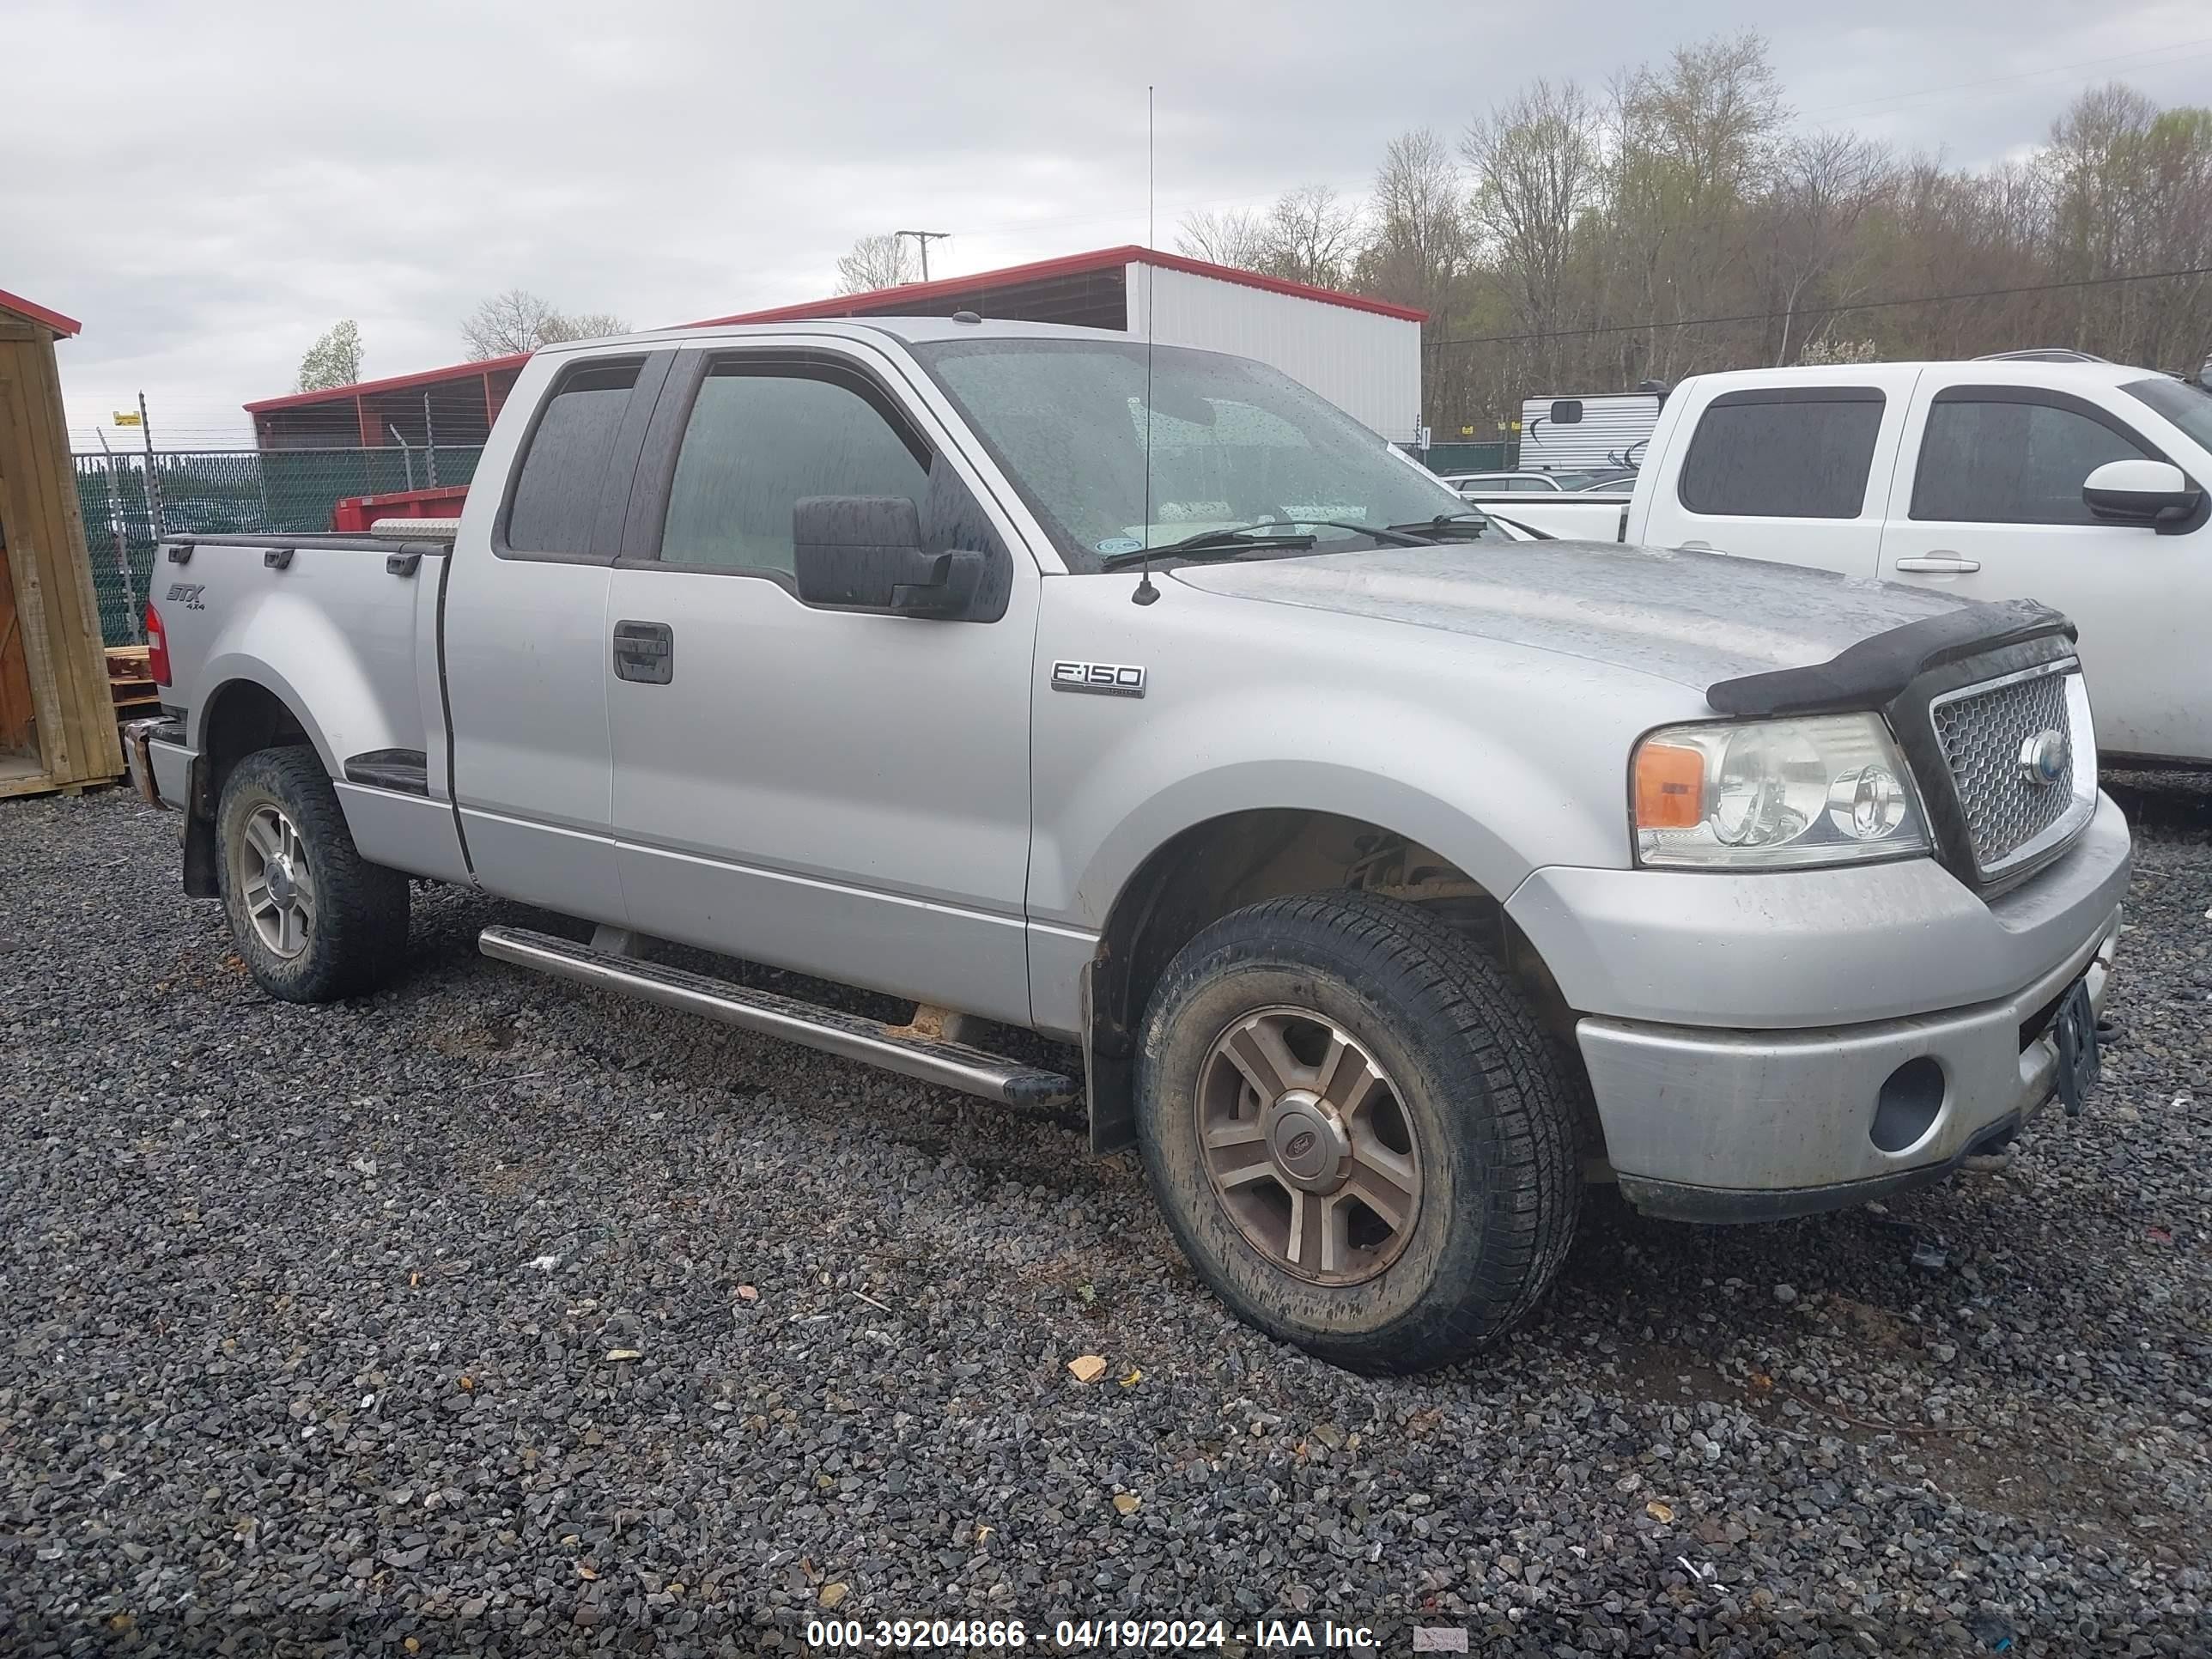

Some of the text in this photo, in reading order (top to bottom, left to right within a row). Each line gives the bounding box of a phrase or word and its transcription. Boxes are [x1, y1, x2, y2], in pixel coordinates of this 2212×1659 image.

[167, 583, 205, 603] STX
[1054, 663, 1142, 686] F-150
[1293, 1138, 1310, 1154] Ford
